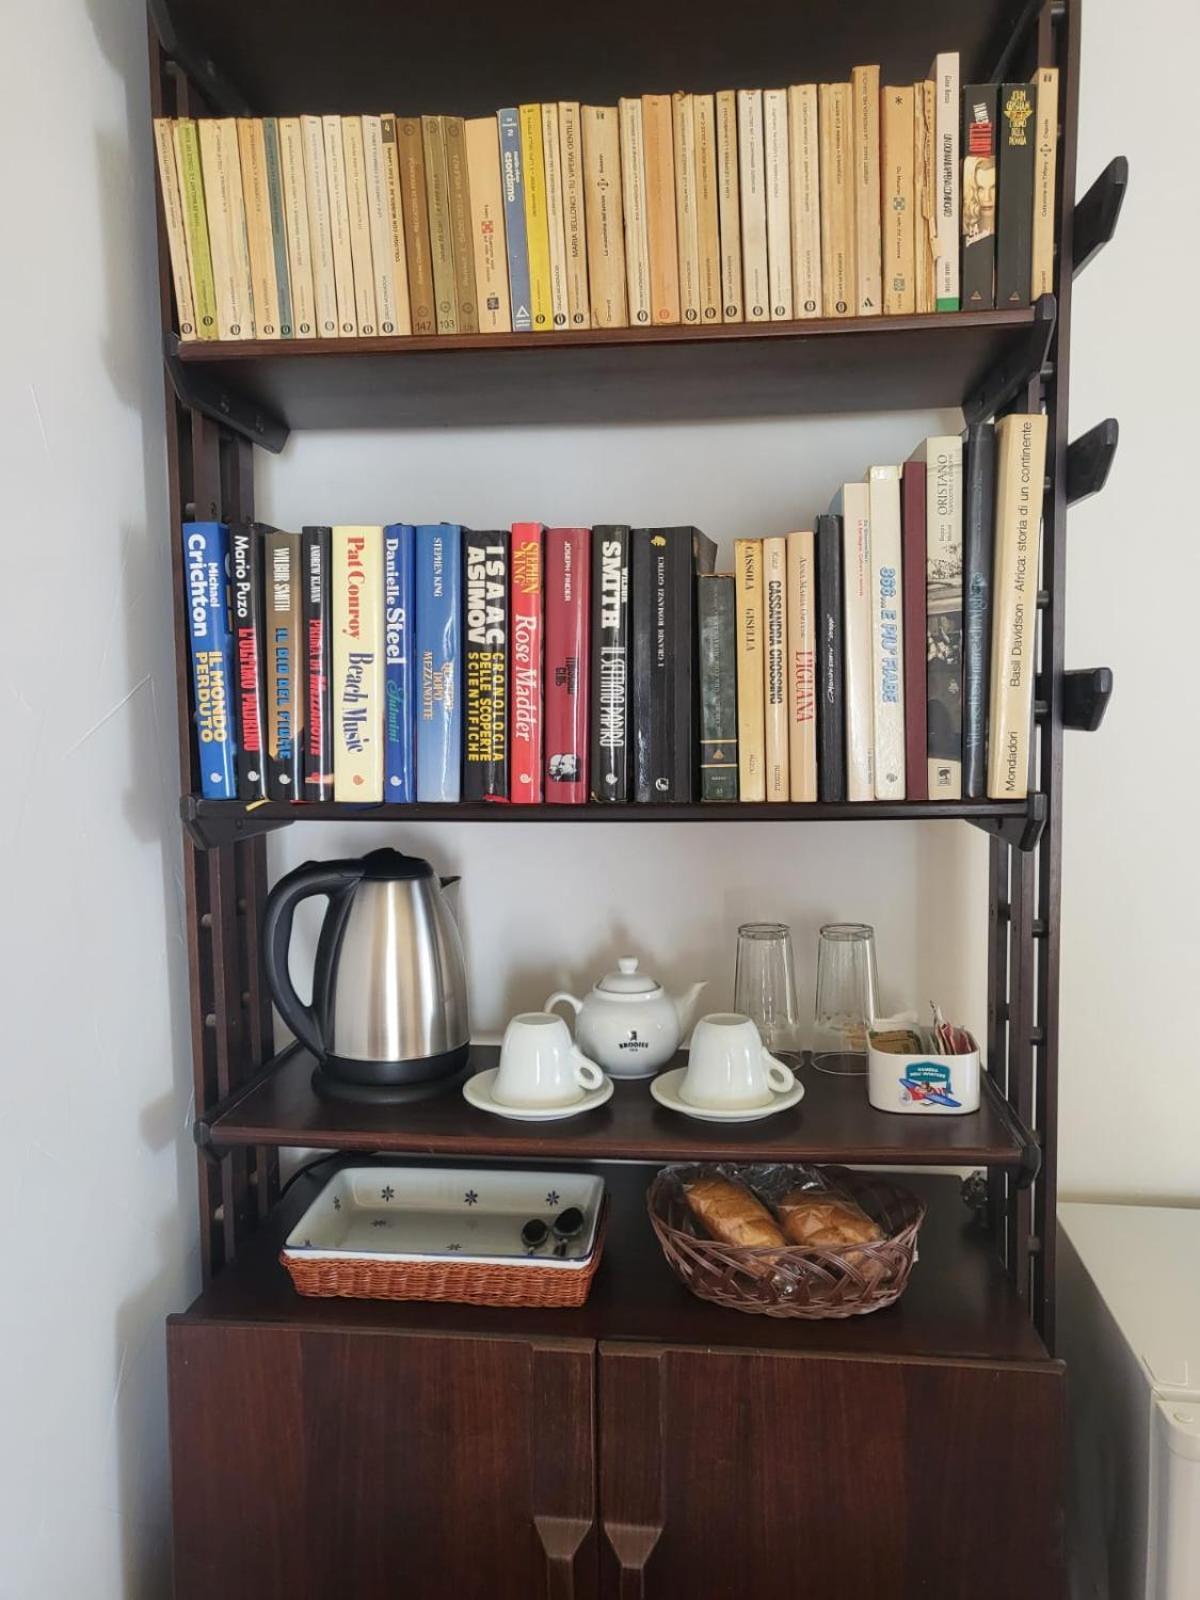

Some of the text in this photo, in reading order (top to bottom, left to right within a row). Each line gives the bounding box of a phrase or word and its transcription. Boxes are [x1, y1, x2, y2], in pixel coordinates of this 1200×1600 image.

[969, 122, 992, 156] ELLROY
[972, 102, 989, 124] JAMES
[567, 152, 576, 178] VIPERA
[568, 180, 576, 190] TU
[1020, 422, 1033, 483] continente
[936, 454, 948, 516] ORISTANO
[1018, 504, 1030, 516] di
[1020, 487, 1030, 501] un
[1018, 518, 1030, 552] storia
[188, 533, 209, 637] Crichton
[208, 562, 221, 607] Michael
[234, 536, 251, 618] Mario Puzo
[274, 547, 290, 612] WILBUR SMITH
[310, 544, 322, 603] ANDREW KLAVAN
[342, 536, 366, 640] Pat Conroy
[433, 537, 444, 597] STEPHEN KING
[468, 546, 486, 644] ASIMOV
[486, 545, 505, 645] ISAAC
[512, 550, 526, 584] KING
[520, 542, 540, 594] STEPHEN
[564, 540, 572, 602] JOSEPH FINDER
[601, 541, 621, 629] SMITH
[799, 558, 808, 578] ANNA
[799, 580, 808, 607] MARIA
[1014, 556, 1026, 592] Africa:
[386, 538, 406, 665] Danielle Steel
[744, 546, 757, 652] CASSOLA GISELLA
[1012, 604, 1025, 656] Davidson
[210, 651, 223, 667] IL
[768, 580, 783, 705] CASSANDRA CROSSING
[1010, 660, 1022, 687] Basil
[196, 652, 213, 742] PERDUTO
[210, 670, 227, 742] MONDO
[238, 627, 258, 752] L'ULTIMO PADRINO
[276, 628, 292, 760] IL DIO DEL FIUME
[308, 619, 327, 756] PRIMA DI MEZZANOTTE
[342, 652, 375, 752] Beach Music
[423, 650, 433, 720] MEZZANOTTE
[432, 672, 444, 700] DOPO
[468, 652, 480, 762] SCIENTIFICHE
[480, 652, 492, 762] DELLE SCOPERTE
[492, 652, 505, 762] CRONOLOGIA
[515, 614, 537, 742] Rose Madder
[600, 646, 625, 747] IL SETTIMO PAPIRO
[796, 650, 814, 723] L'IGUANA
[882, 657, 898, 703] FIABE
[1005, 731, 1020, 792] Mondadori
